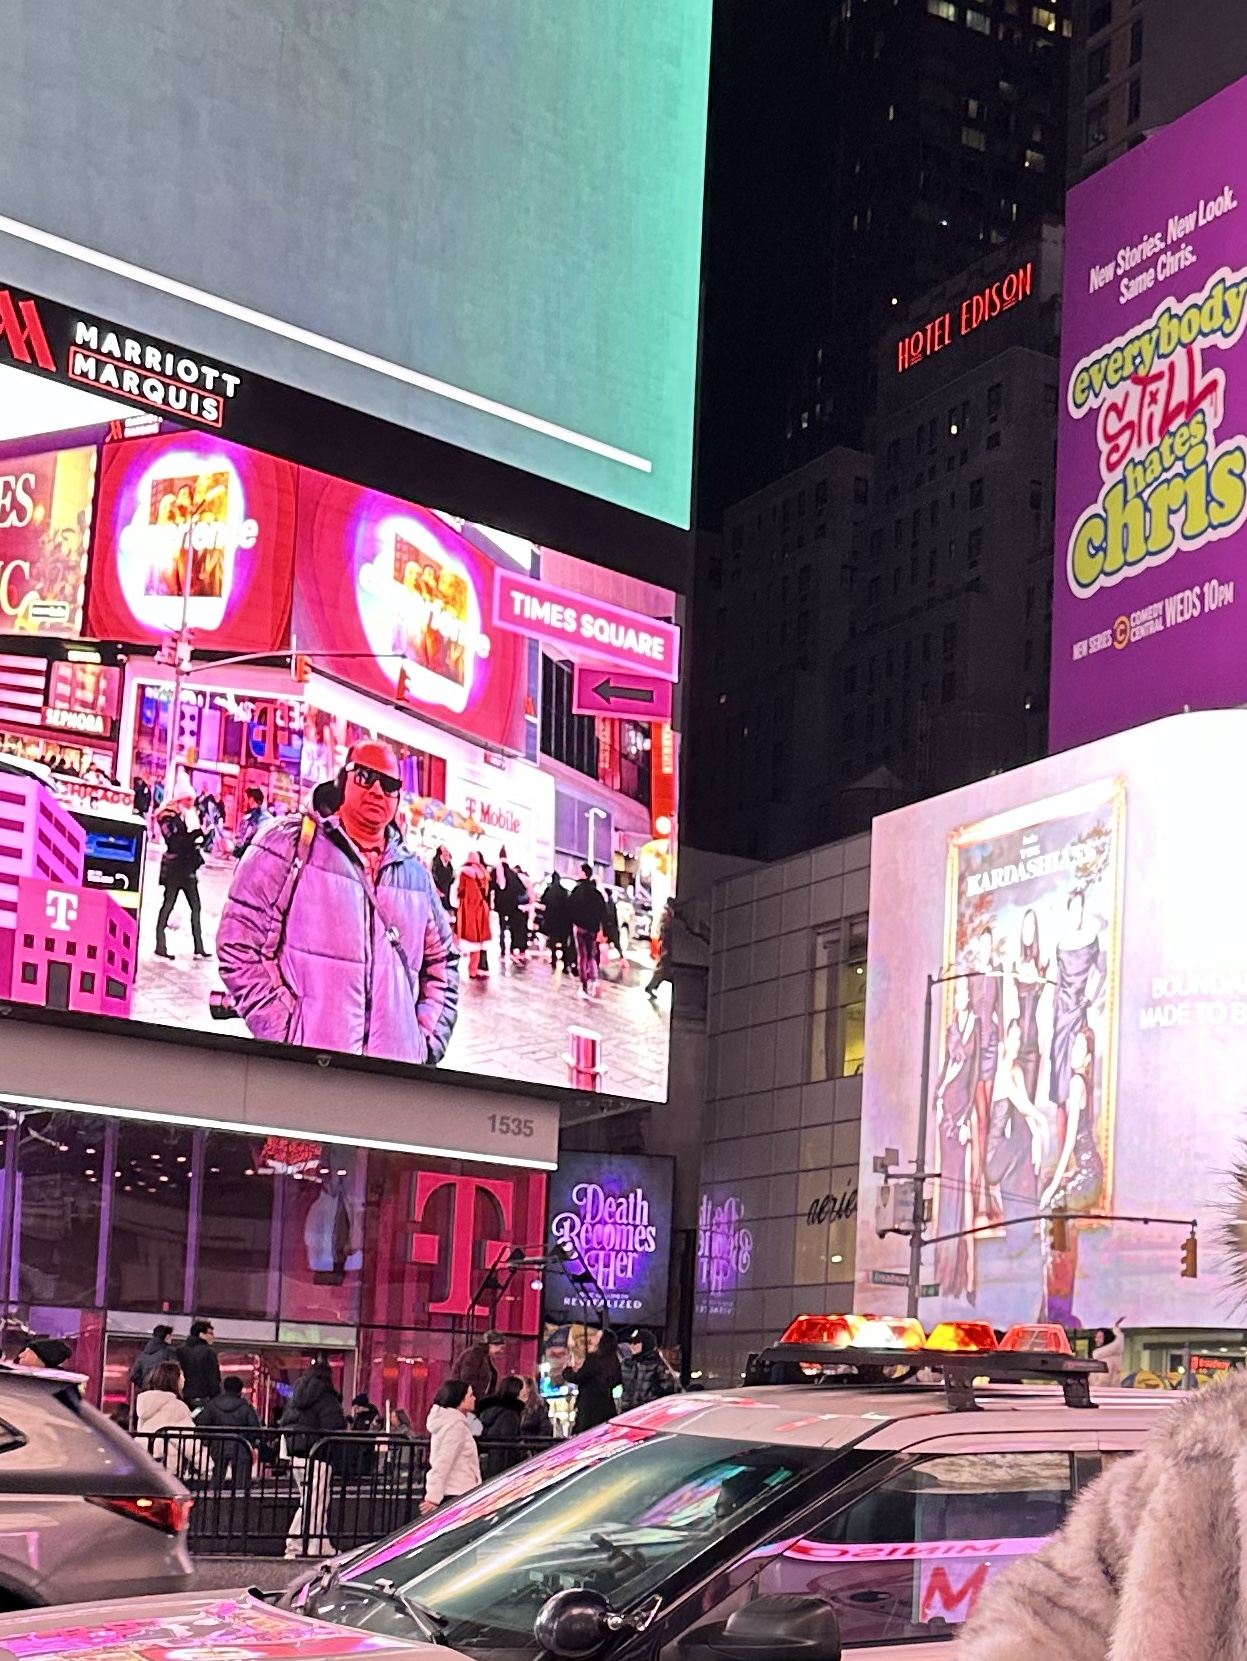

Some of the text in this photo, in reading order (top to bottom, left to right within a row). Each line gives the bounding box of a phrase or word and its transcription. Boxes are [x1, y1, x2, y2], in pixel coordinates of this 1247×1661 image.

[1088, 186, 1238, 294] New Stories. New Look.
[1119, 243, 1197, 304] Same Chris.
[897, 261, 1032, 373] HOTEL EDISON
[75, 321, 241, 398] MARRIOTT
[73, 353, 219, 421] MARQUIS
[1123, 408, 1207, 499] hates
[1072, 442, 1247, 589] chris
[510, 590, 666, 661] TIMES SQUARE
[1130, 601, 1163, 627] COMEDY
[1165, 585, 1201, 628] WEDS
[1072, 640, 1088, 661] NEW
[1089, 629, 1113, 654] SERIES
[1131, 615, 1164, 643] CENTRAL
[46, 706, 104, 734] SEPHORA
[480, 801, 521, 833] Mobile
[1139, 1002, 1192, 1030] MADE
[1194, 1001, 1227, 1025] TO
[487, 1113, 535, 1138] 1535
[572, 1183, 649, 1225] Death
[584, 1250, 639, 1290] Her
